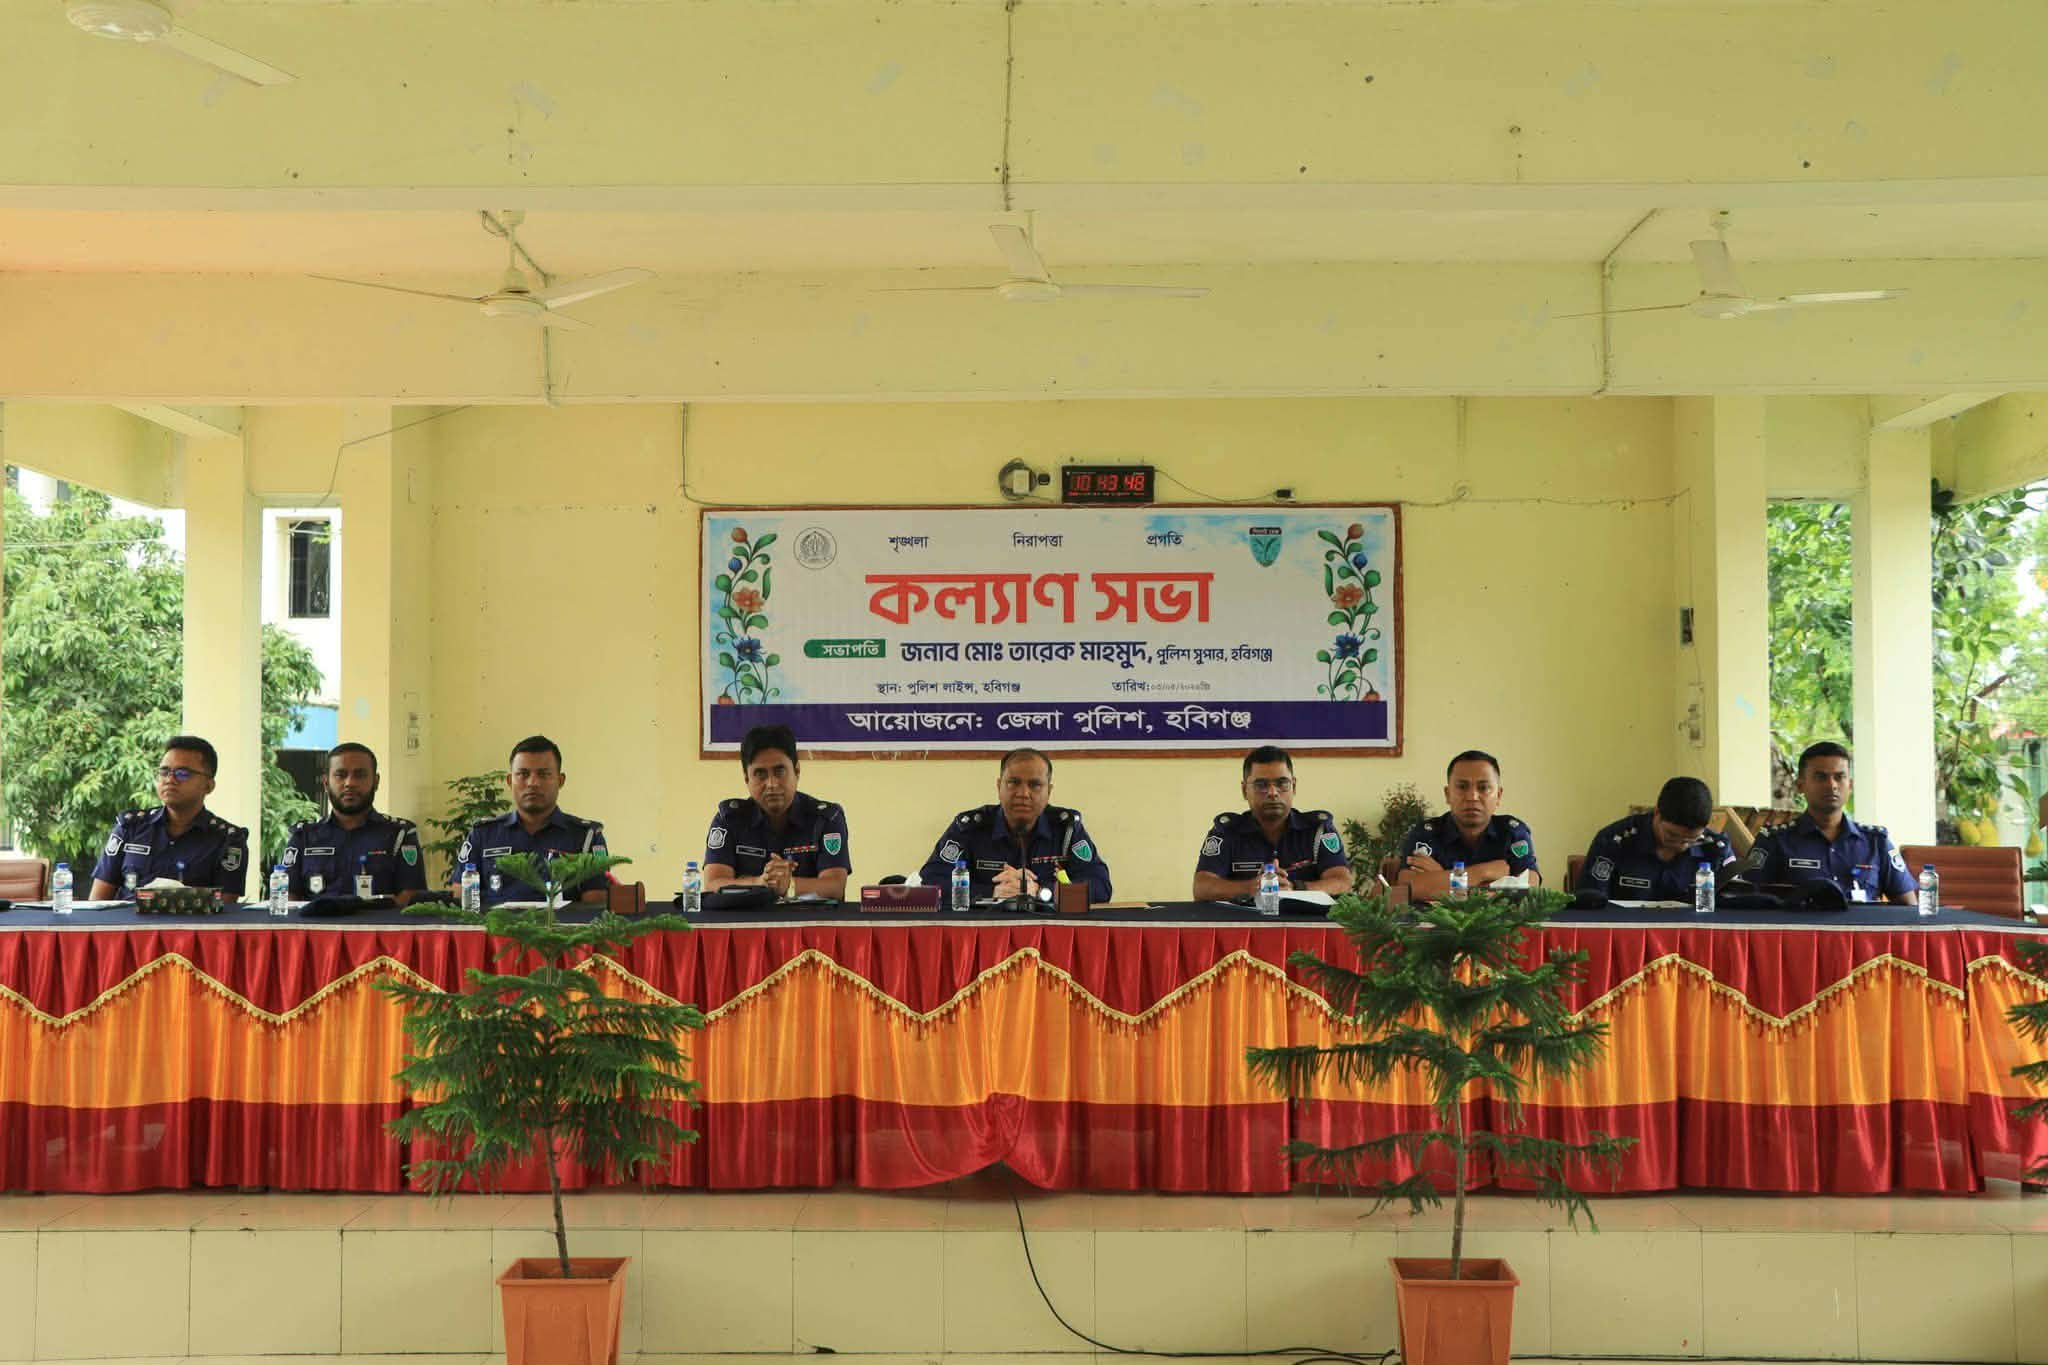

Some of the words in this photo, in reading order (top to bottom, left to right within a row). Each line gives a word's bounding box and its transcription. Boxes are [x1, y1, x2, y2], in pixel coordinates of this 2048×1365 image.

[1013, 532, 1063, 547] নিরাপত্তা
[1147, 531, 1183, 546] প্রগতি
[865, 573, 1079, 625] কল্যাণ
[1091, 572, 1214, 624] সভা
[822, 639, 881, 657] সভাপতি
[900, 642, 960, 663] জনাব
[965, 641, 1003, 662] মোঃ
[1008, 641, 1076, 663] তারেক
[1079, 641, 1152, 669] মাহমুদ,
[1156, 644, 1191, 666] পুলিশ
[1193, 648, 1228, 666] সুপার,
[1231, 644, 1273, 663] হবিগঞ্জ
[907, 679, 939, 696] পুলিশ
[982, 679, 1021, 694] হবিগঞ্জ
[847, 707, 983, 732] আয়োজনে:
[997, 709, 1064, 731] জেলা
[1073, 705, 1153, 735] পুলিশ,
[1163, 705, 1251, 732] হবিগঞ্জ
